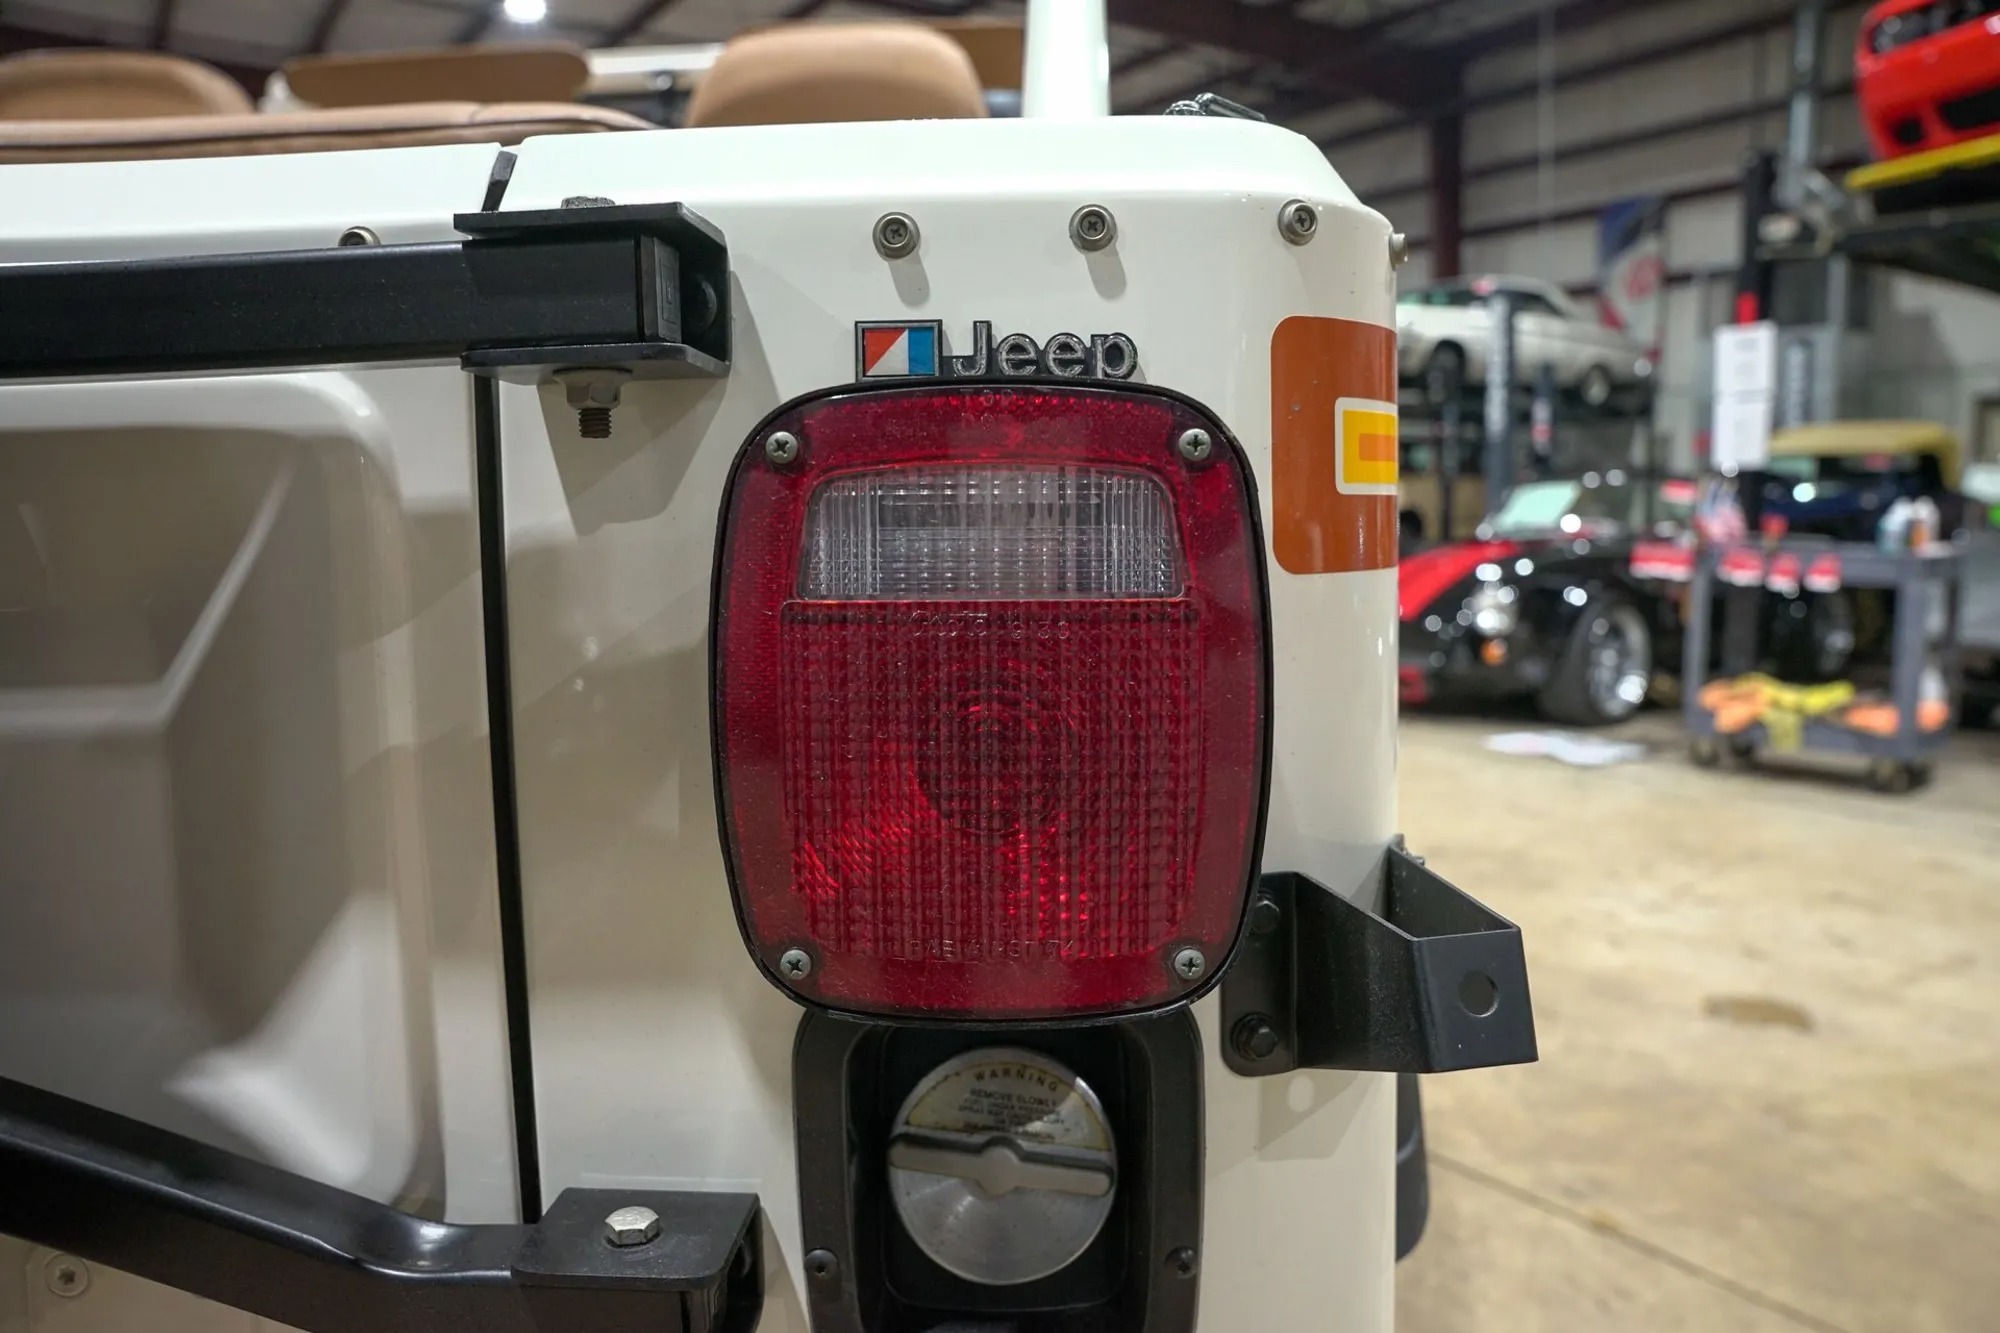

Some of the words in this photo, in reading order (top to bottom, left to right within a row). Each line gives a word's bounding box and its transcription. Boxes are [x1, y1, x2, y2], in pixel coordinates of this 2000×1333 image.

[951, 320, 1138, 379] Jeep
[974, 1067, 1058, 1092] WARNING
[970, 1088, 1012, 1102] REMOVE
